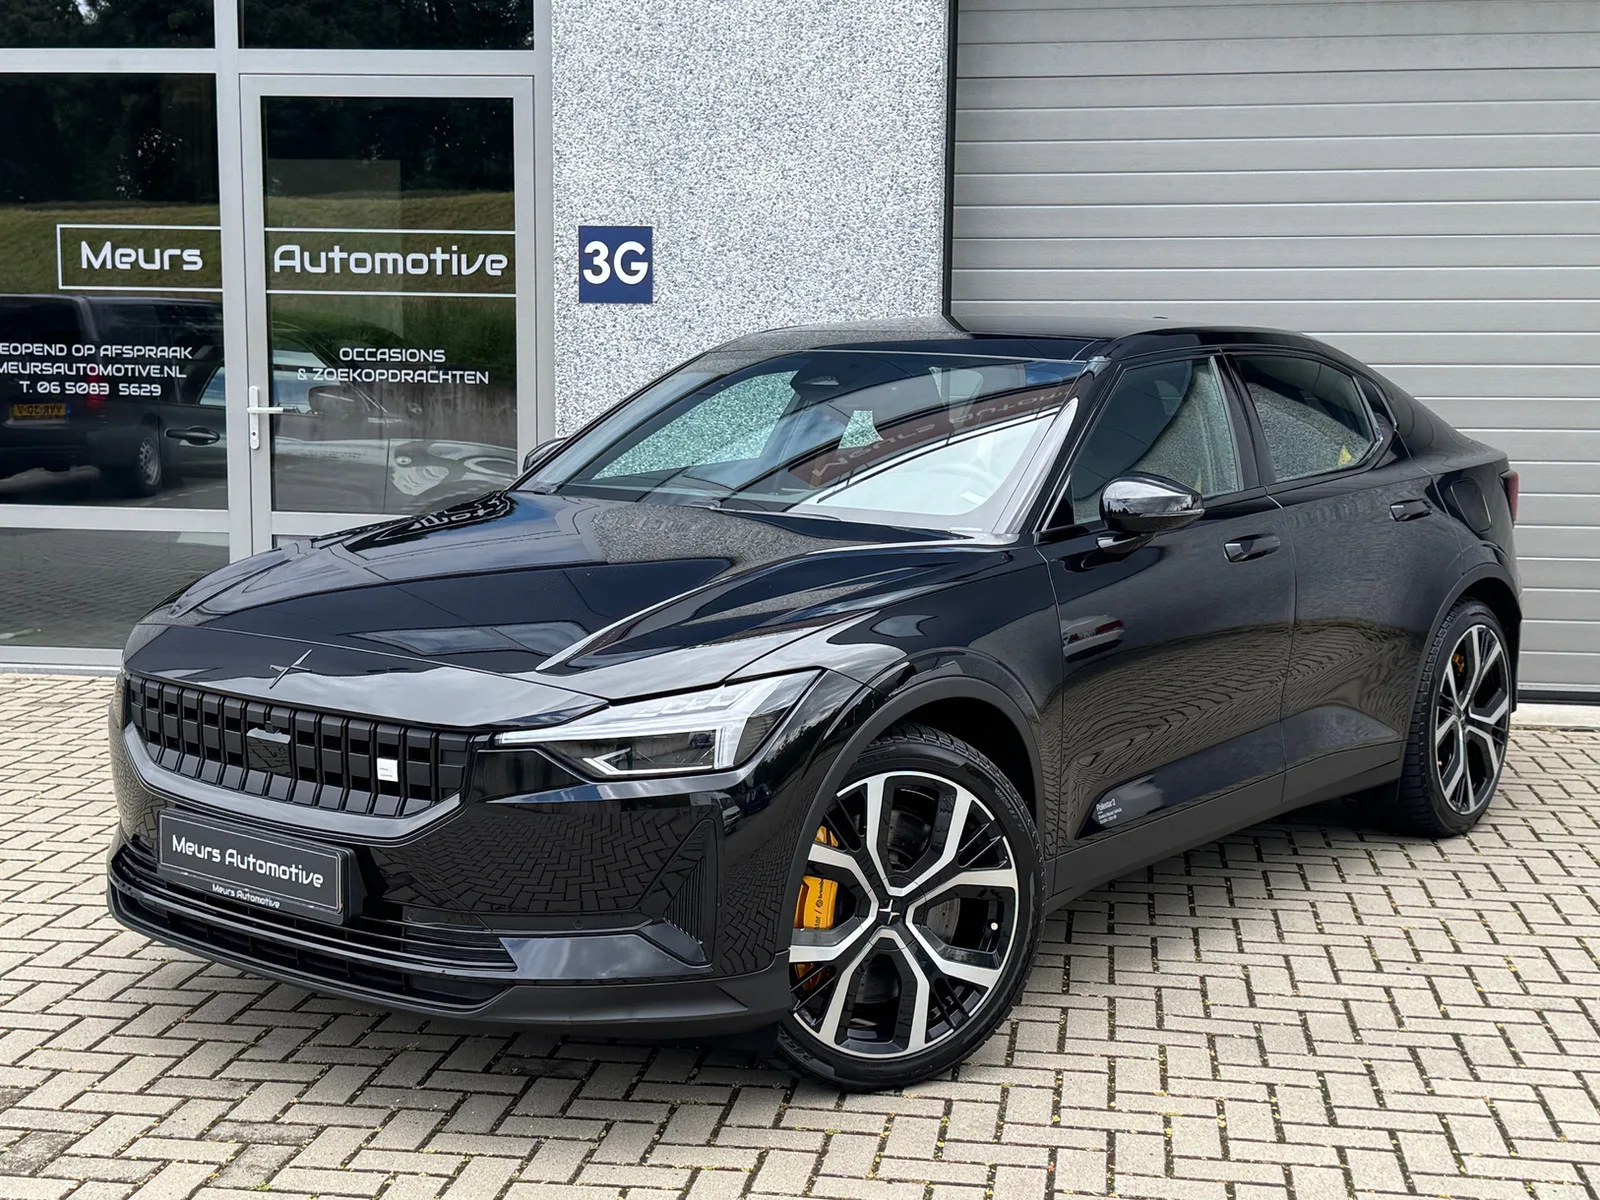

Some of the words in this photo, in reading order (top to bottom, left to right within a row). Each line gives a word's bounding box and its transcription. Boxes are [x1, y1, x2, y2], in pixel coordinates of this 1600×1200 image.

[80, 240, 204, 271] Meurs
[273, 244, 508, 276] Automotive
[582, 240, 649, 285] 3G
[71, 344, 96, 357] OP
[100, 345, 193, 360] AFSPRAAK
[339, 347, 446, 363] OCCASIONS
[297, 368, 308, 381] &
[312, 368, 489, 384] ZOEKOPDRACHTEN
[19, 380, 33, 393] T.
[37, 381, 61, 394] 06
[65, 382, 110, 395] 5083
[118, 383, 162, 396] 5629
[172, 834, 221, 863] Meurs
[225, 848, 324, 888] Automotive
[211, 883, 236, 898] Meurs
[236, 889, 281, 909] Automotive
